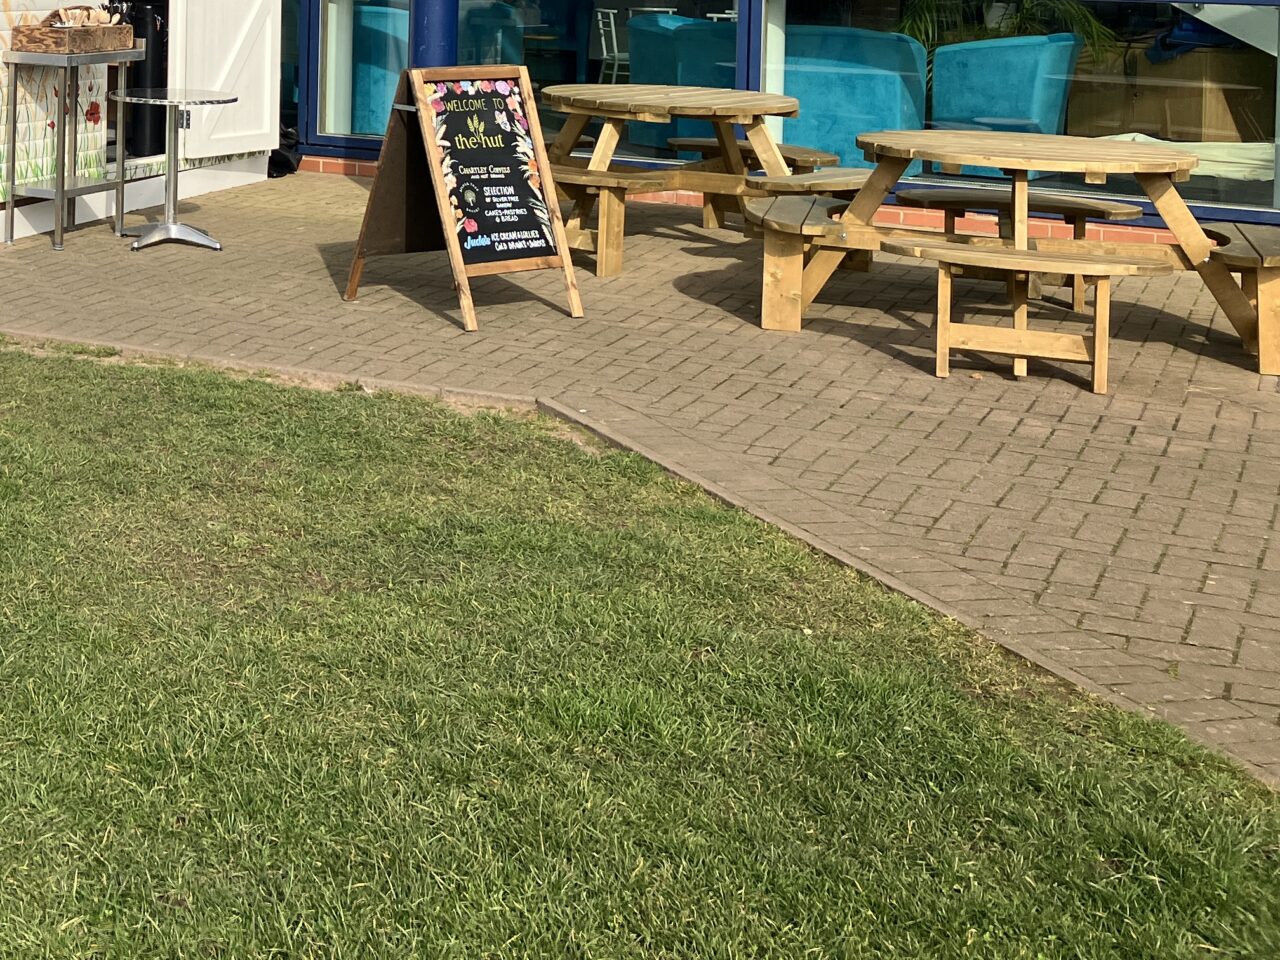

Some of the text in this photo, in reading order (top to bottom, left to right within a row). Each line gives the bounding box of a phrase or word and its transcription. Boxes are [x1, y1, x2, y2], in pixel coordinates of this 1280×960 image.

[444, 97, 505, 112] WELCOME TO
[454, 132, 505, 150] the hut
[458, 165, 487, 175] CHARTLEY
[482, 185, 515, 197] SELECTION
[490, 233, 500, 242] ICE
[500, 231, 517, 241] CREAM
